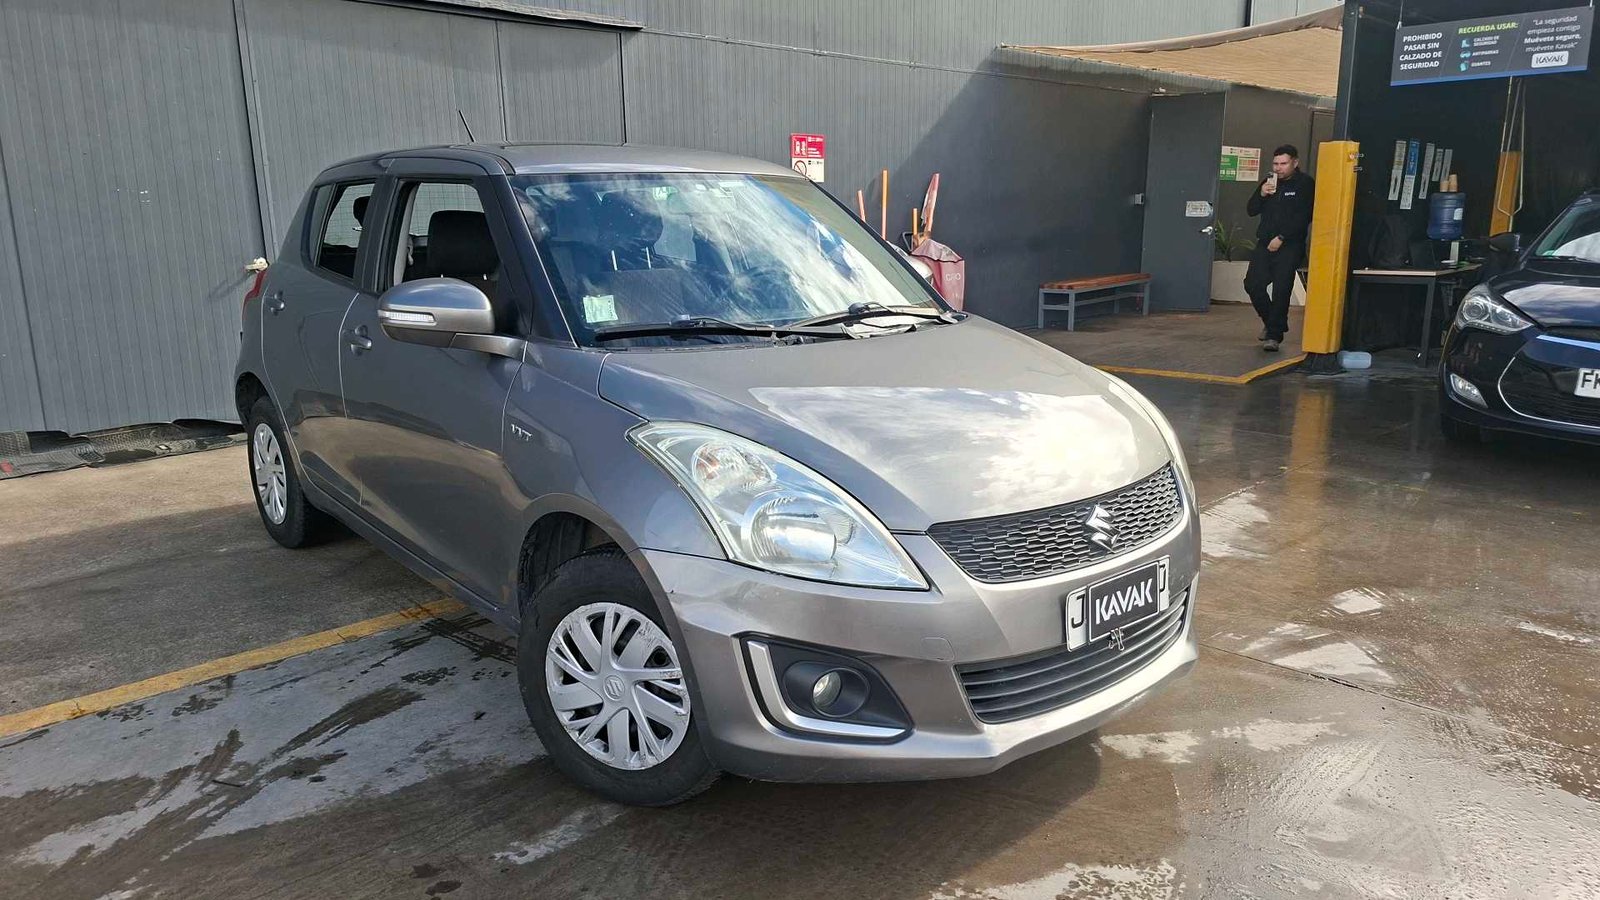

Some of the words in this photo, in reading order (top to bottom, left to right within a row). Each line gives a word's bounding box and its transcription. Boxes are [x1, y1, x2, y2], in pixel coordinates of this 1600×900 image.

[1545, 15, 1577, 25] seguridad
[1459, 24, 1495, 34] RECUERDA
[1497, 22, 1518, 30] USAR:
[1403, 32, 1442, 42] PROHIBIDO
[1404, 43, 1426, 51] PASAR
[1400, 52, 1431, 61] CALZADO
[1536, 55, 1564, 64] KAVAK
[1400, 61, 1439, 70] SEGURIDAD
[1095, 578, 1153, 625] KAVAK
